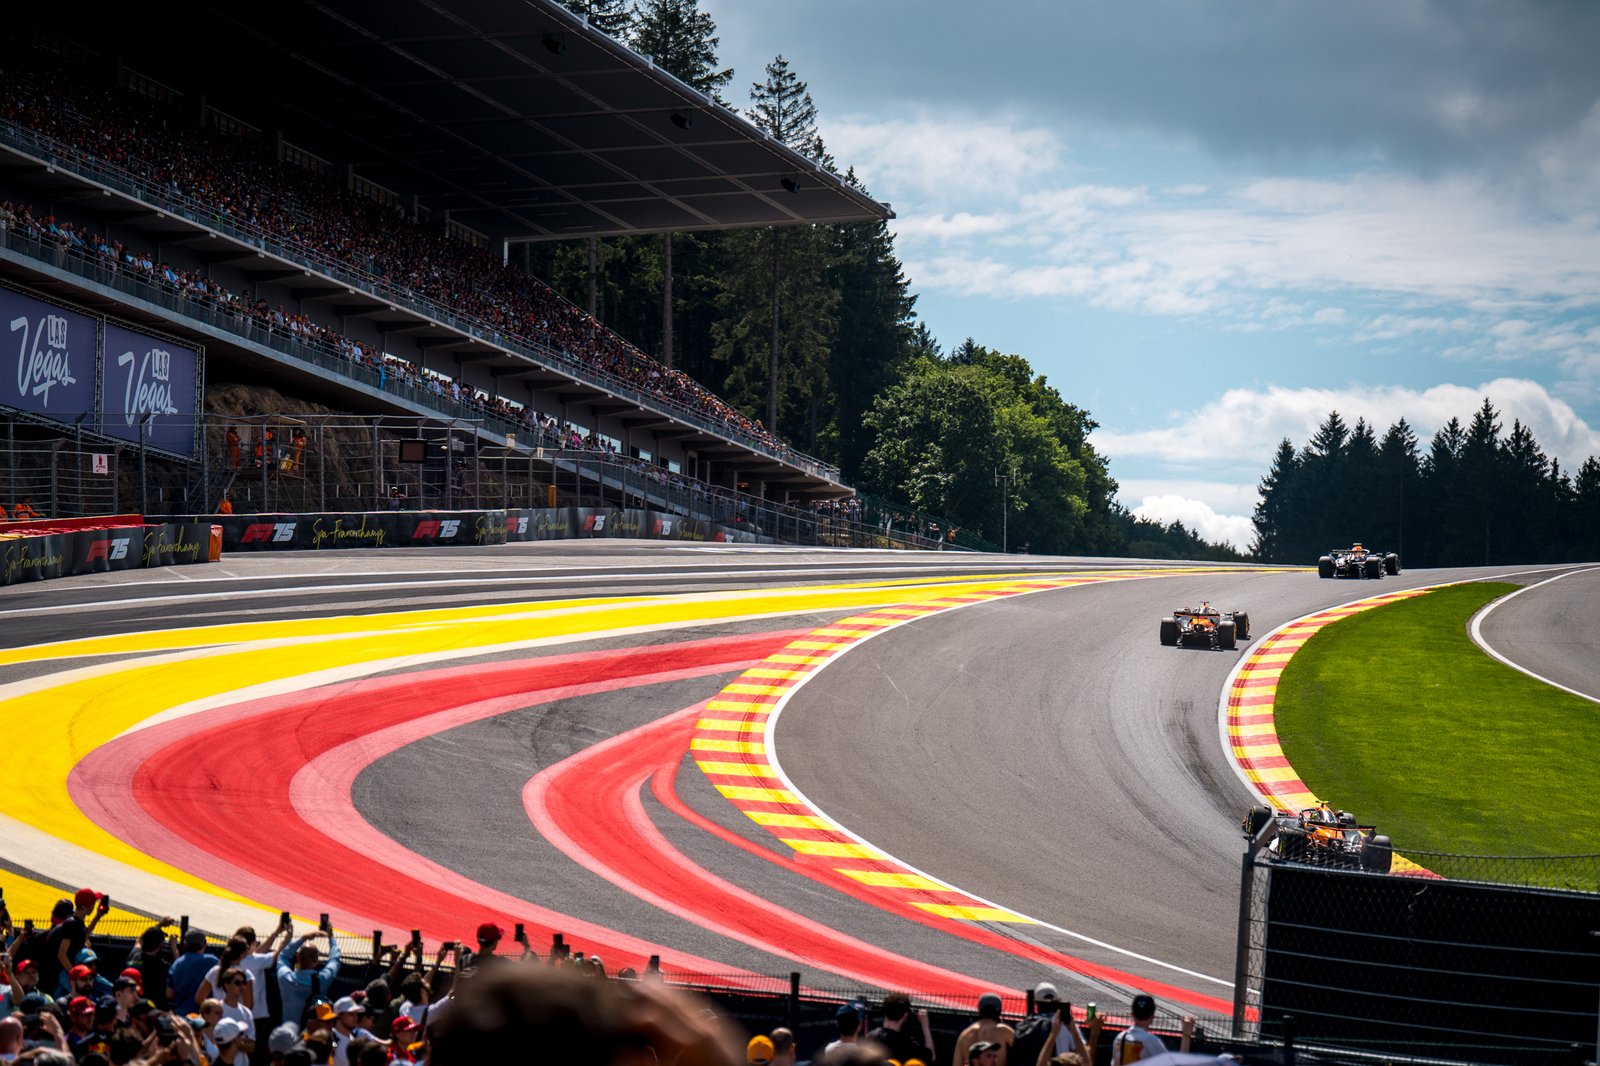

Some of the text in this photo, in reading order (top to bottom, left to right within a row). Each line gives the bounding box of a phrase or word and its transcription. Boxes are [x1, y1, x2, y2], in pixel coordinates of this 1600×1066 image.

[48, 315, 67, 348] LAS
[10, 316, 76, 408] Vegas
[152, 349, 170, 381] LAS
[118, 351, 178, 437] Vegas
